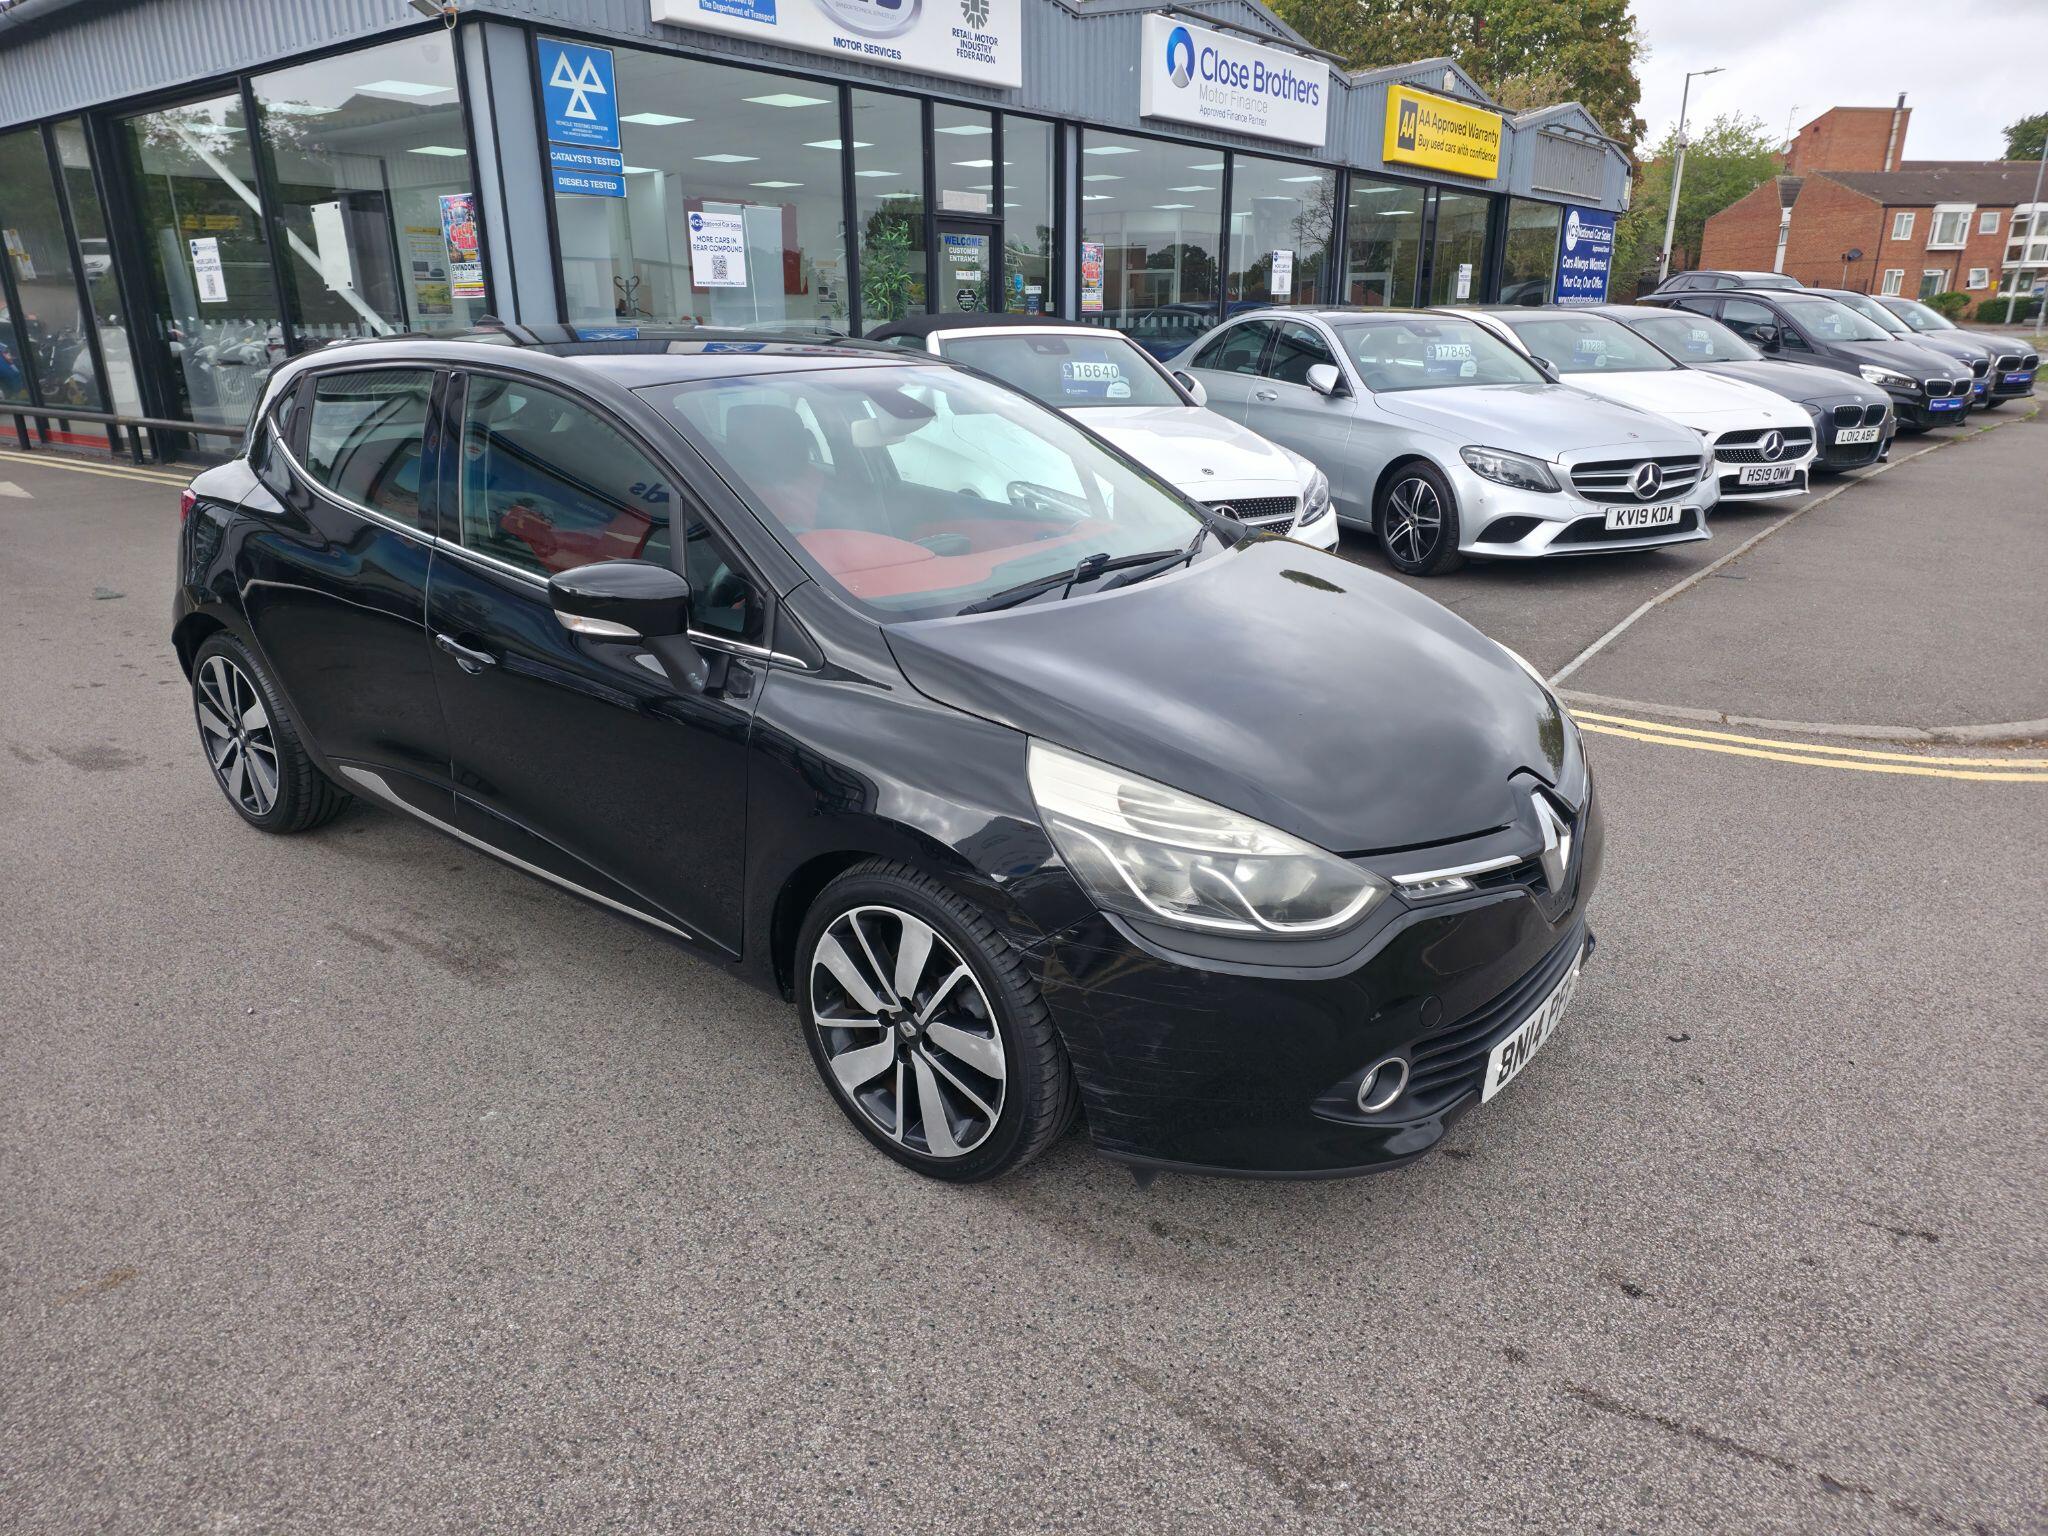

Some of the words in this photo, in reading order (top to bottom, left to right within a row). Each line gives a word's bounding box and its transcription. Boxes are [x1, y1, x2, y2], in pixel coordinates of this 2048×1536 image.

[713, 3, 743, 16] Department
[744, 8, 750, 17] of
[751, 10, 775, 22] Transport
[952, 28, 973, 40] RETAIL
[974, 30, 999, 46] MOTOR
[833, 36, 862, 54] MOTOR
[864, 44, 902, 60] SERVICES
[960, 39, 992, 54] INDUSTRY
[956, 48, 996, 64] FEDERATION
[1200, 47, 1249, 89] Close
[1254, 61, 1319, 106] Brothers
[1200, 83, 1228, 106] Motor
[1231, 91, 1268, 113] Finance
[1200, 105, 1226, 119] Approved
[1227, 109, 1248, 123] Finance
[1249, 114, 1267, 127] Partner
[1400, 111, 1415, 139] AA
[1418, 109, 1430, 127] AA
[1432, 113, 1468, 136] Approved
[1469, 122, 1499, 148] Warranty
[1418, 134, 1430, 151] Buy
[1431, 140, 1444, 151] used
[1445, 144, 1456, 154] cars
[1457, 145, 1468, 157] with
[1470, 148, 1496, 162] confidence
[551, 152, 592, 164] CATALYSTS
[593, 156, 621, 167] TESTED
[558, 177, 589, 188] DIESELS
[590, 180, 617, 190] TESTED
[696, 235, 713, 243] MORE
[715, 236, 730, 244] CARS
[944, 236, 983, 246] WELCOME
[1579, 227, 1595, 239] National
[1601, 229, 1611, 241] Sales
[709, 245, 743, 253] COMPOUND
[949, 247, 979, 255] CUSTOMER
[949, 255, 979, 263] ENTRANCE
[1562, 256, 1574, 268] Cars
[1574, 256, 1589, 272] Always
[1563, 275, 1573, 287] Your
[1583, 276, 1591, 288] Our
[1841, 431, 1860, 442] LO12
[1861, 430, 1876, 441] ABF
[1747, 468, 1772, 482] HS19
[1616, 509, 1648, 526] KV19
[1651, 506, 1673, 523] KDA
[1497, 1009, 1546, 1087] BN14
